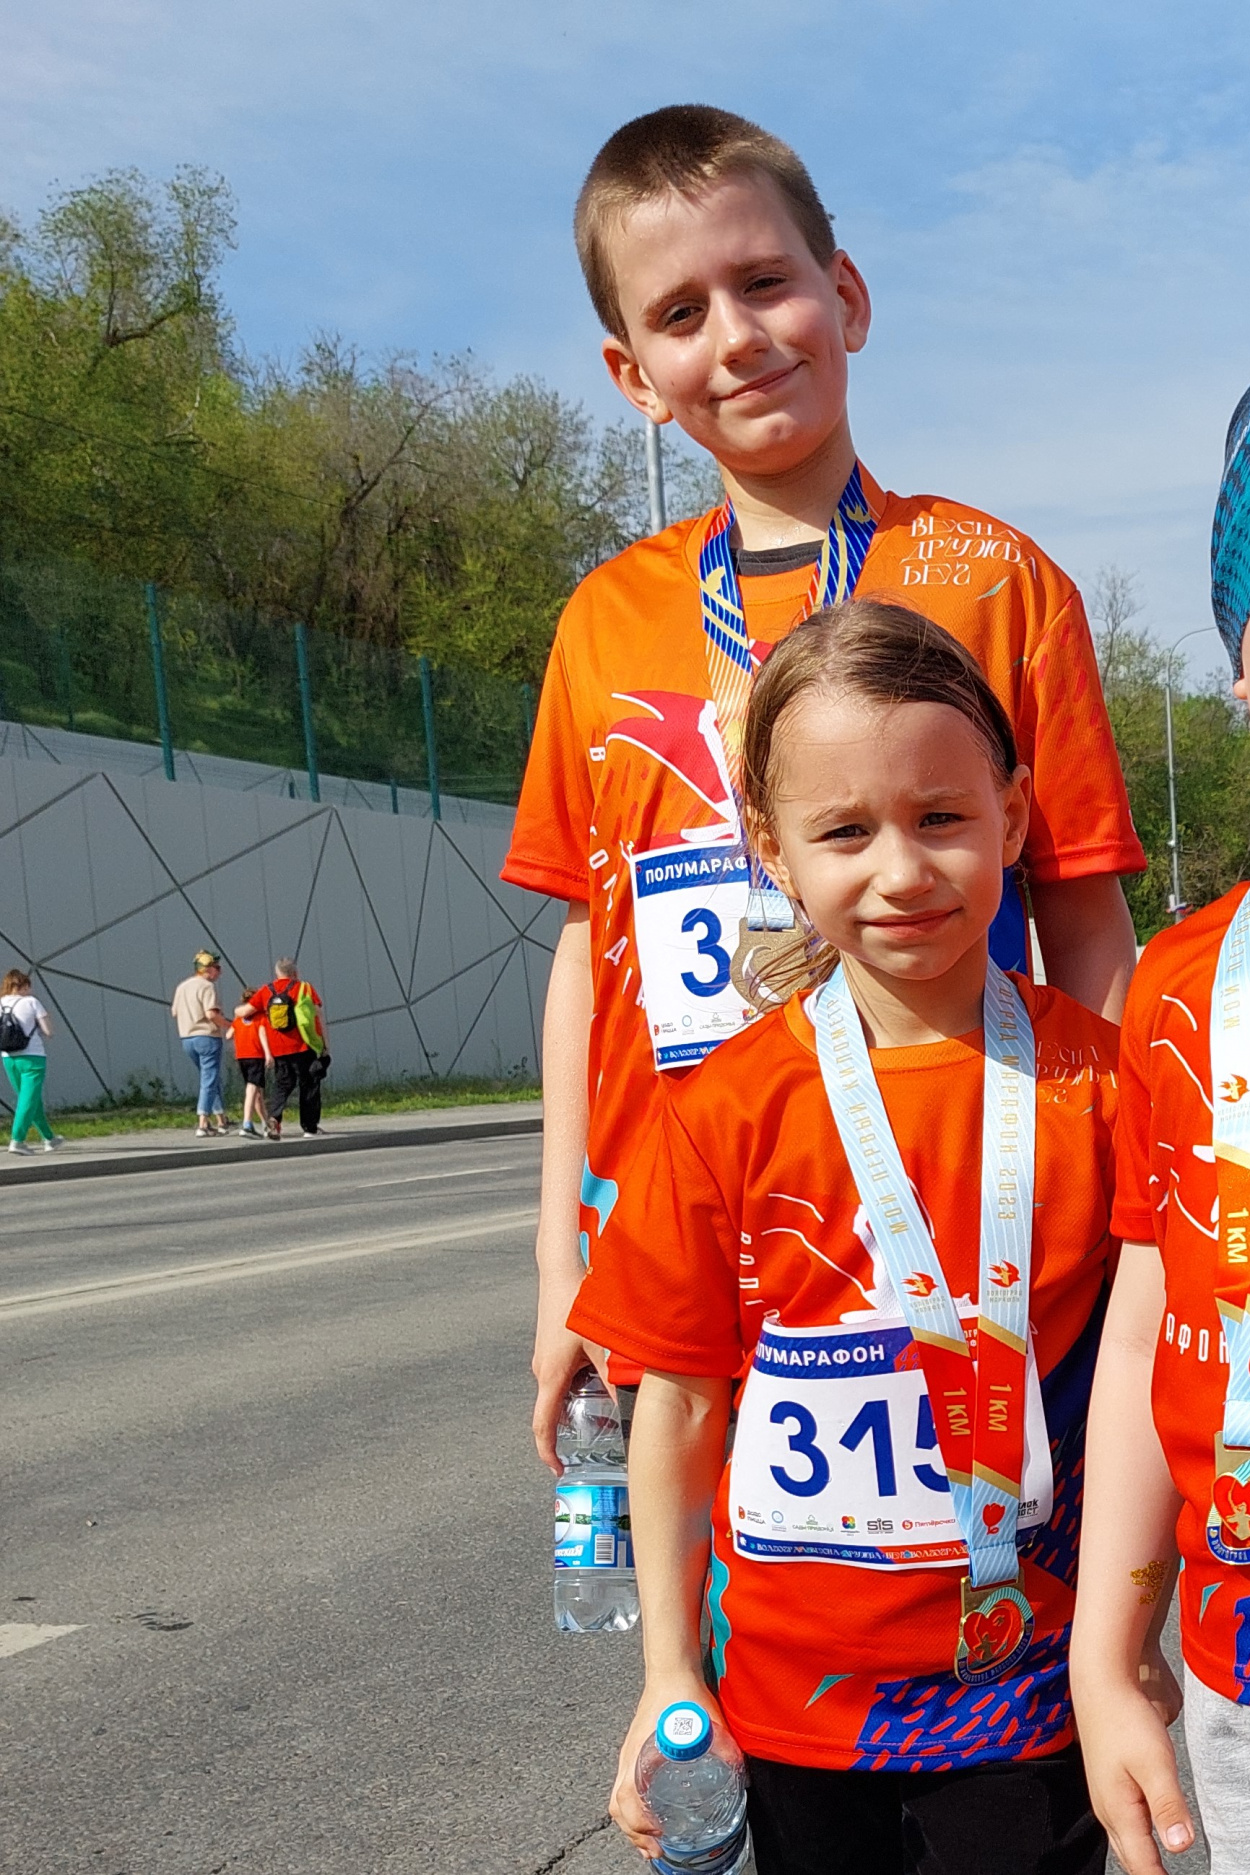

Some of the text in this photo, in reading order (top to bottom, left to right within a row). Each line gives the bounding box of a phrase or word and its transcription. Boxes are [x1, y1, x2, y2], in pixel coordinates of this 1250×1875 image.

[645, 857, 748, 885] ПОЛУМАРАФ
[680, 907, 731, 998] 3
[826, 999, 909, 1235] МОЙ ПЕРВЫЙ КИЛОМЕТР
[999, 1055, 1020, 1153] МАРАФОН
[998, 1168, 1017, 1220] 2023
[1227, 1207, 1249, 1219] 1
[757, 1344, 885, 1367] ЛУМАРАФОН
[943, 1388, 967, 1399] 1
[989, 1383, 1012, 1394] 1
[769, 1399, 951, 1498] 315
